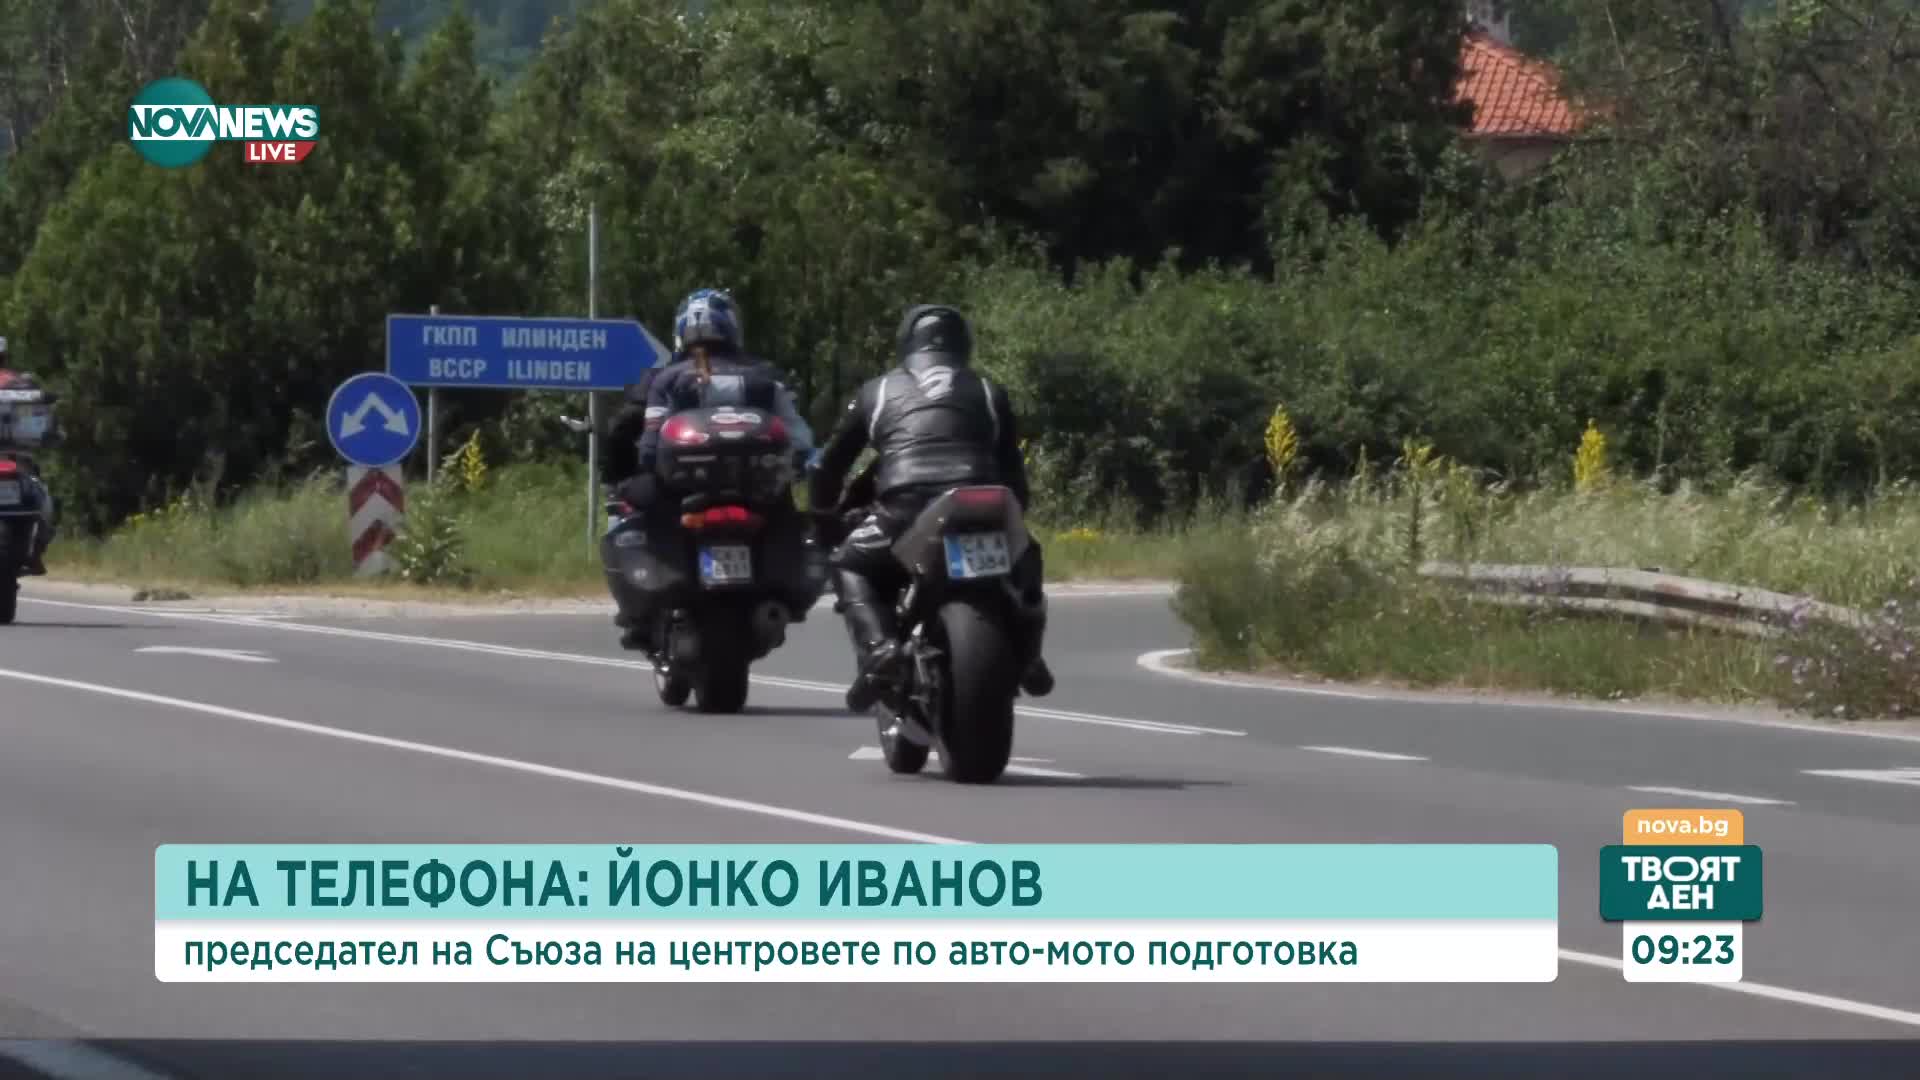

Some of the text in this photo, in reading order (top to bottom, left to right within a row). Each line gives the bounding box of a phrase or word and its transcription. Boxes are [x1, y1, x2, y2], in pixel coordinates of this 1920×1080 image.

[422, 325, 608, 352] ГКПП ИЛИНДЕН
[507, 359, 591, 381] ILINDEN
